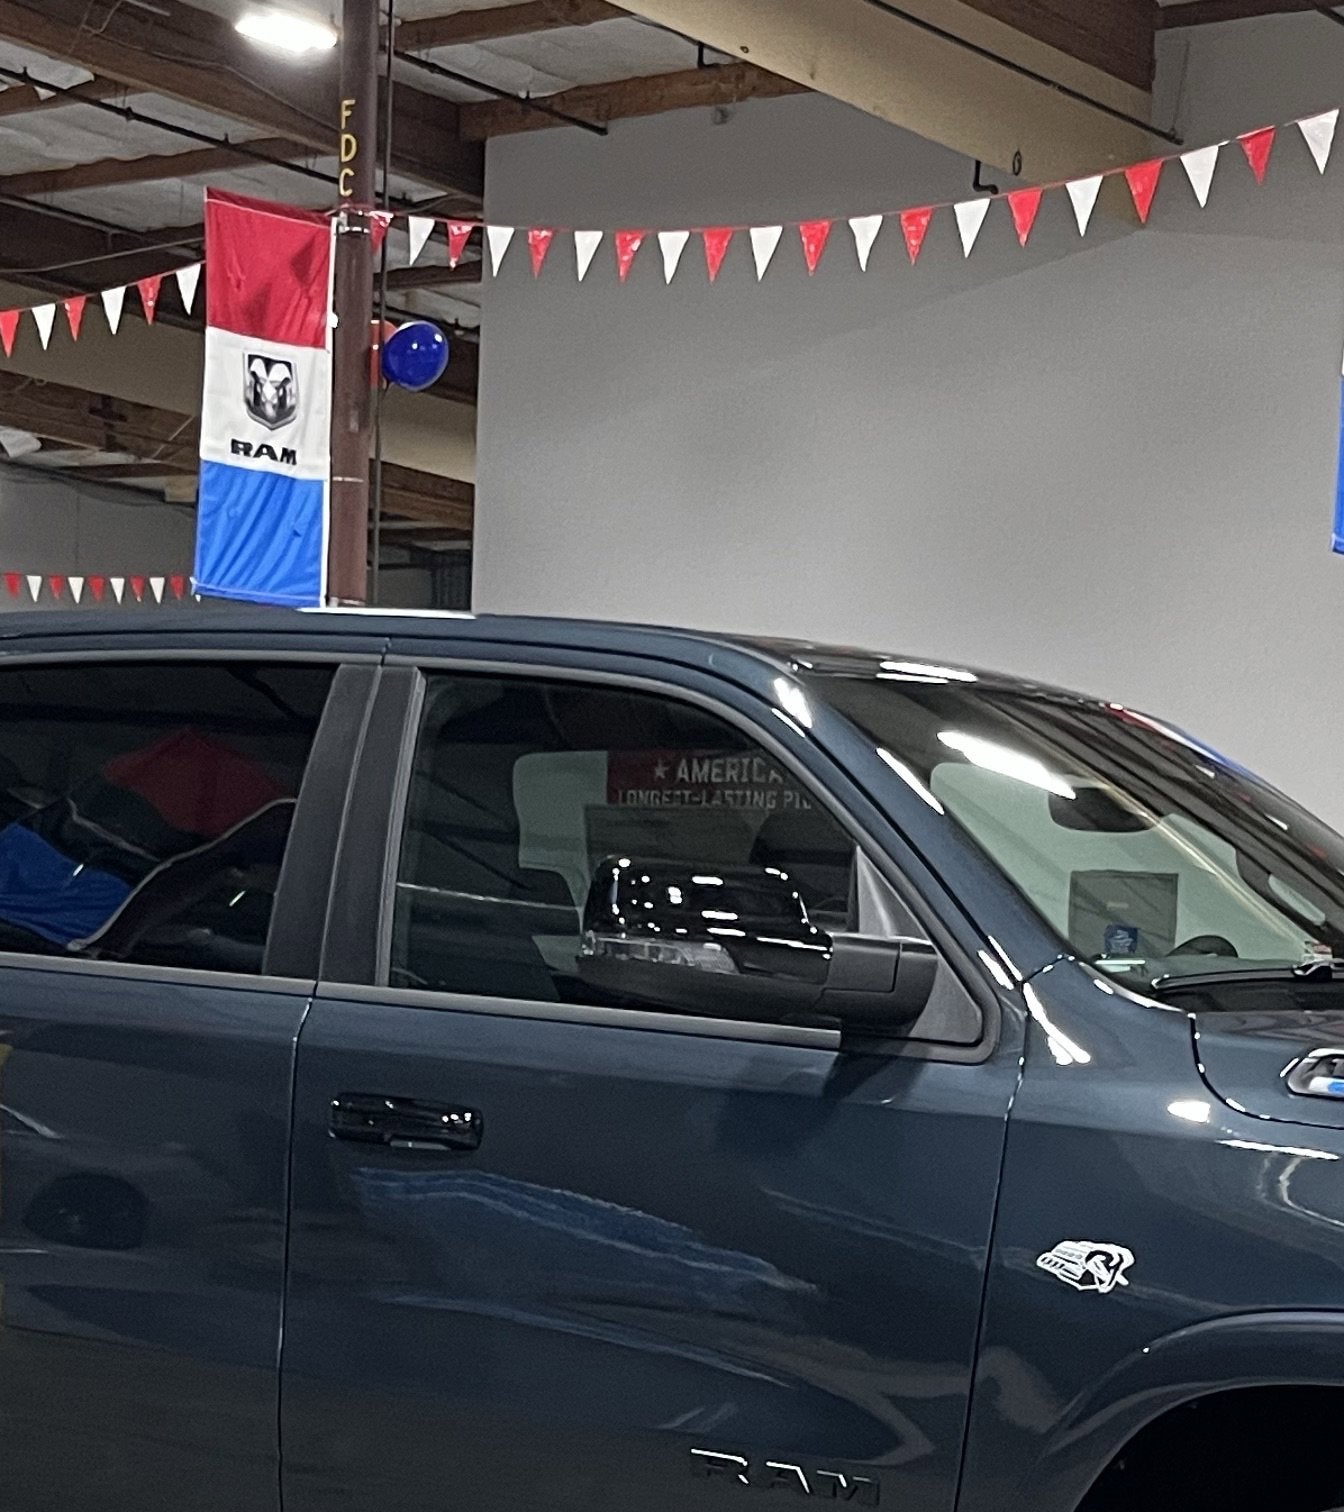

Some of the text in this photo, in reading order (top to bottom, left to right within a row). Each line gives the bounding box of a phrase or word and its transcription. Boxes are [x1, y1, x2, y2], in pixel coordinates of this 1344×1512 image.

[339, 99, 357, 197] FDC
[231, 438, 298, 466] RAM
[690, 1448, 881, 1506] RAM
